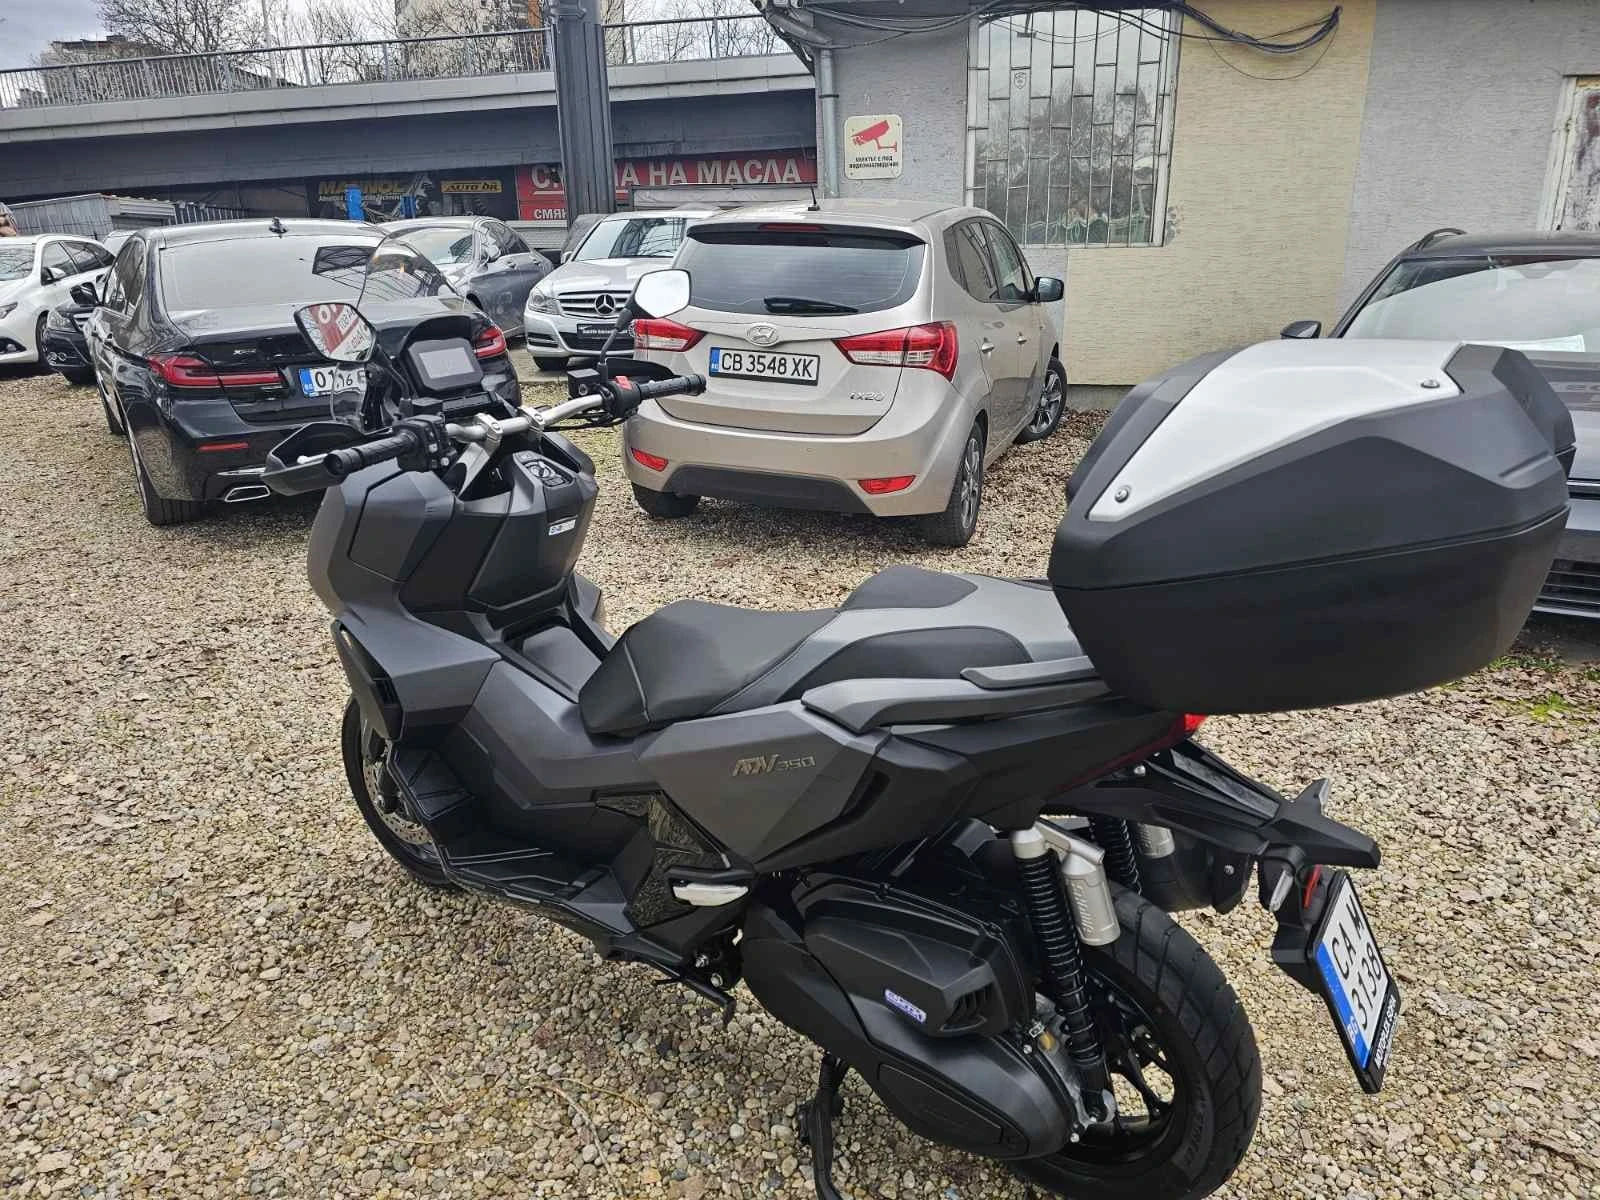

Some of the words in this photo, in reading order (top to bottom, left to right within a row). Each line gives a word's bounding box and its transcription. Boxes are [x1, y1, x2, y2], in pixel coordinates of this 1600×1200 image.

[649, 160, 688, 186] НА
[697, 158, 802, 184] МАСЛА
[721, 352, 742, 371] CB
[746, 354, 787, 375] 3548
[790, 357, 814, 378] XK
[1331, 921, 1357, 981] CA
[1345, 894, 1365, 940] M
[1352, 942, 1382, 1031] 3138
